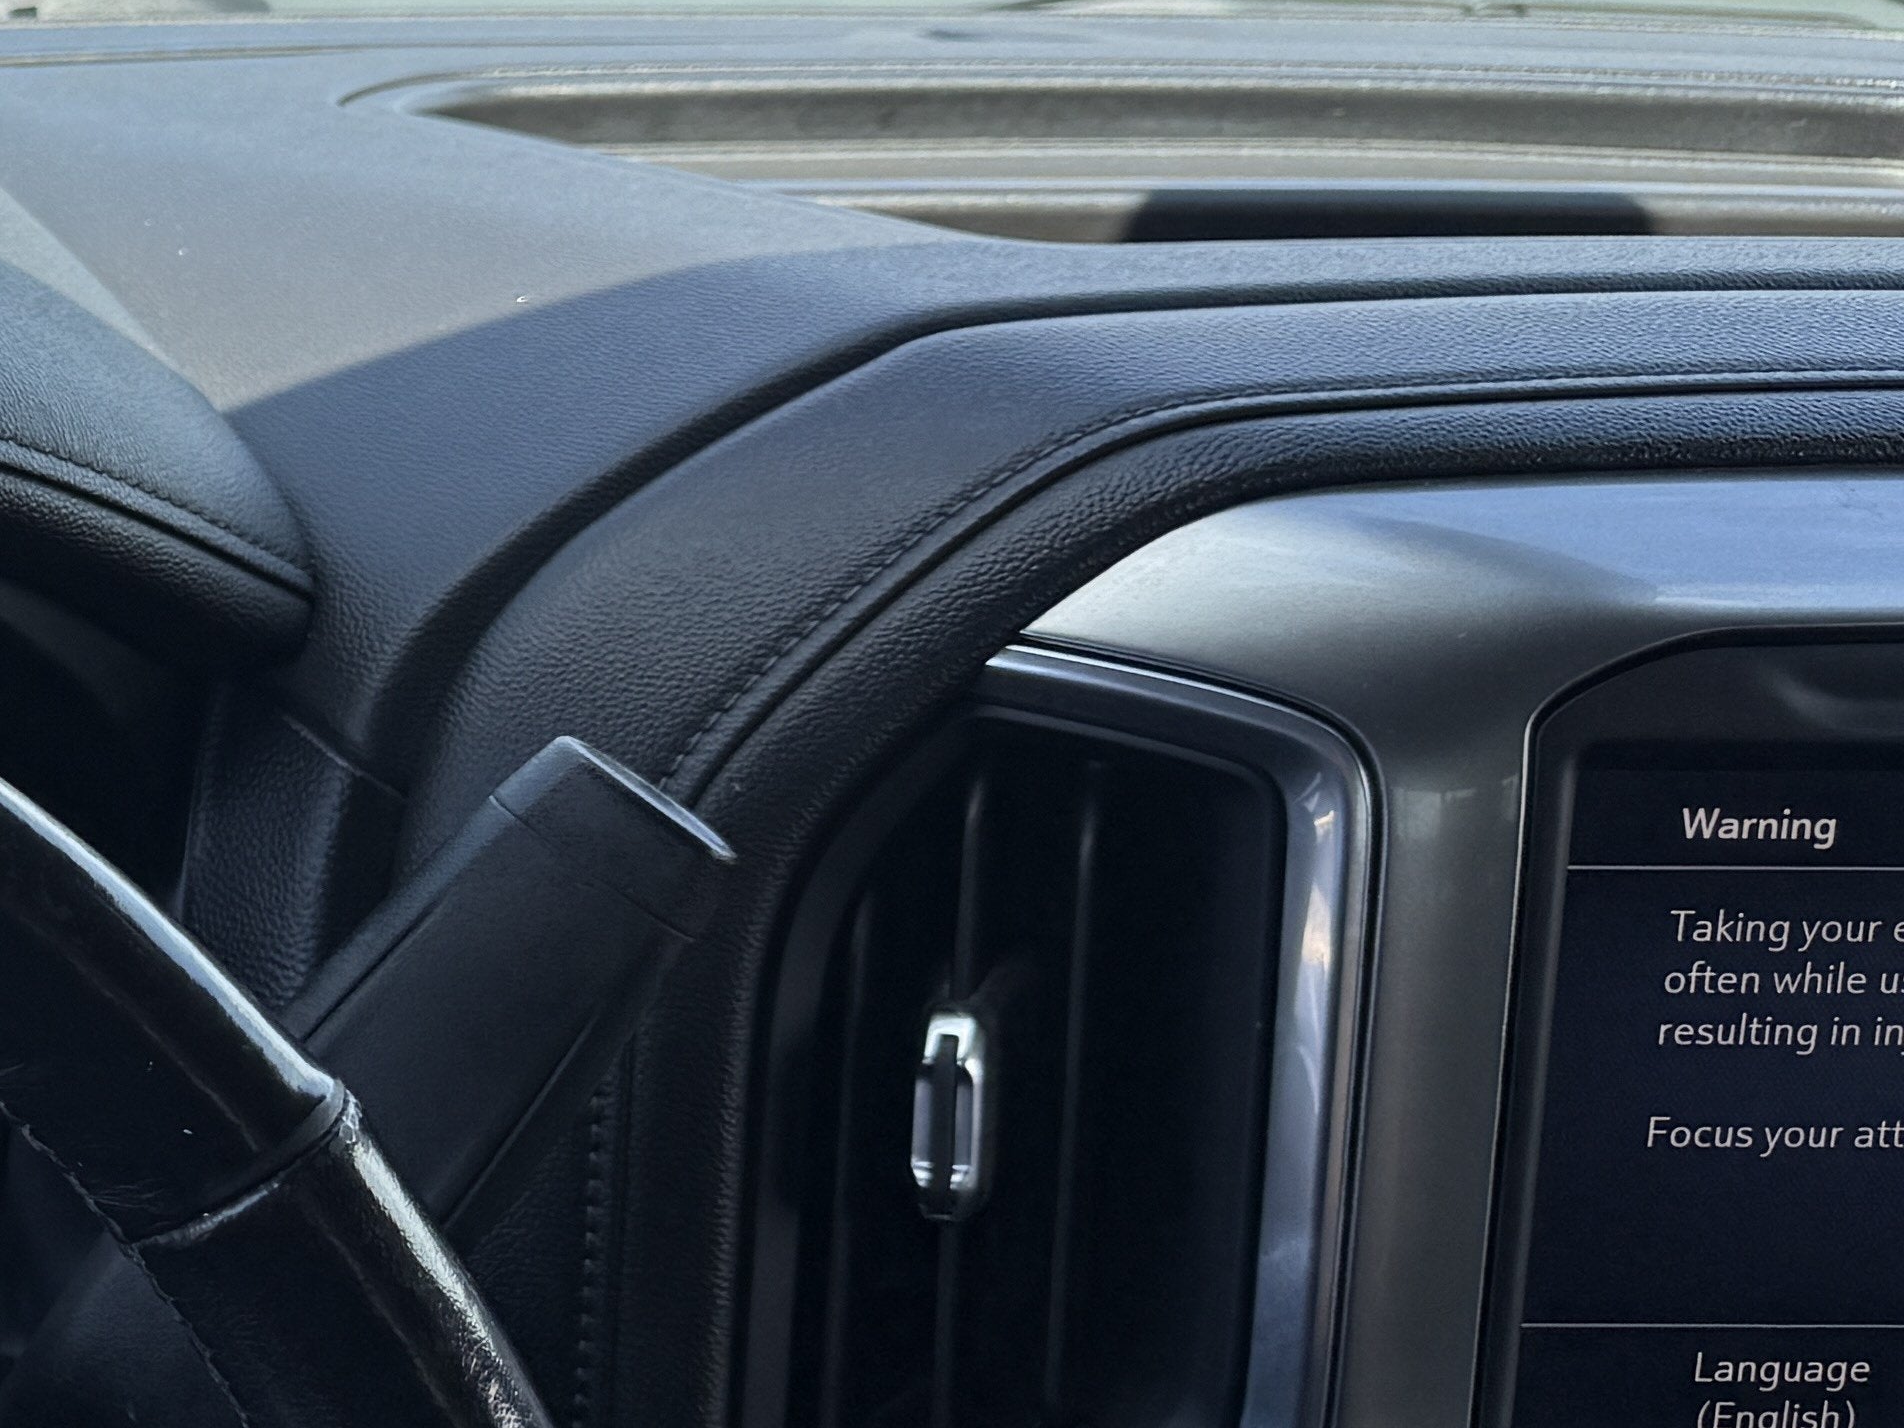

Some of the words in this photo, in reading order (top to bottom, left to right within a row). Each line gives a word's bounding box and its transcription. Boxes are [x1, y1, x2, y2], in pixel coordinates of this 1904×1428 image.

[1682, 807, 1838, 850] Warning
[1670, 909, 1791, 952] Taking
[1798, 921, 1882, 952] your
[1664, 961, 1761, 995] often
[1770, 961, 1867, 994] while
[1880, 973, 1904, 994] u
[1657, 1014, 1817, 1055] resulting
[1831, 1017, 1860, 1045] in
[1874, 1017, 1904, 1056] in
[1646, 1116, 1754, 1150] Focus
[1759, 1123, 1844, 1159] your
[1694, 1352, 1871, 1395] Language
